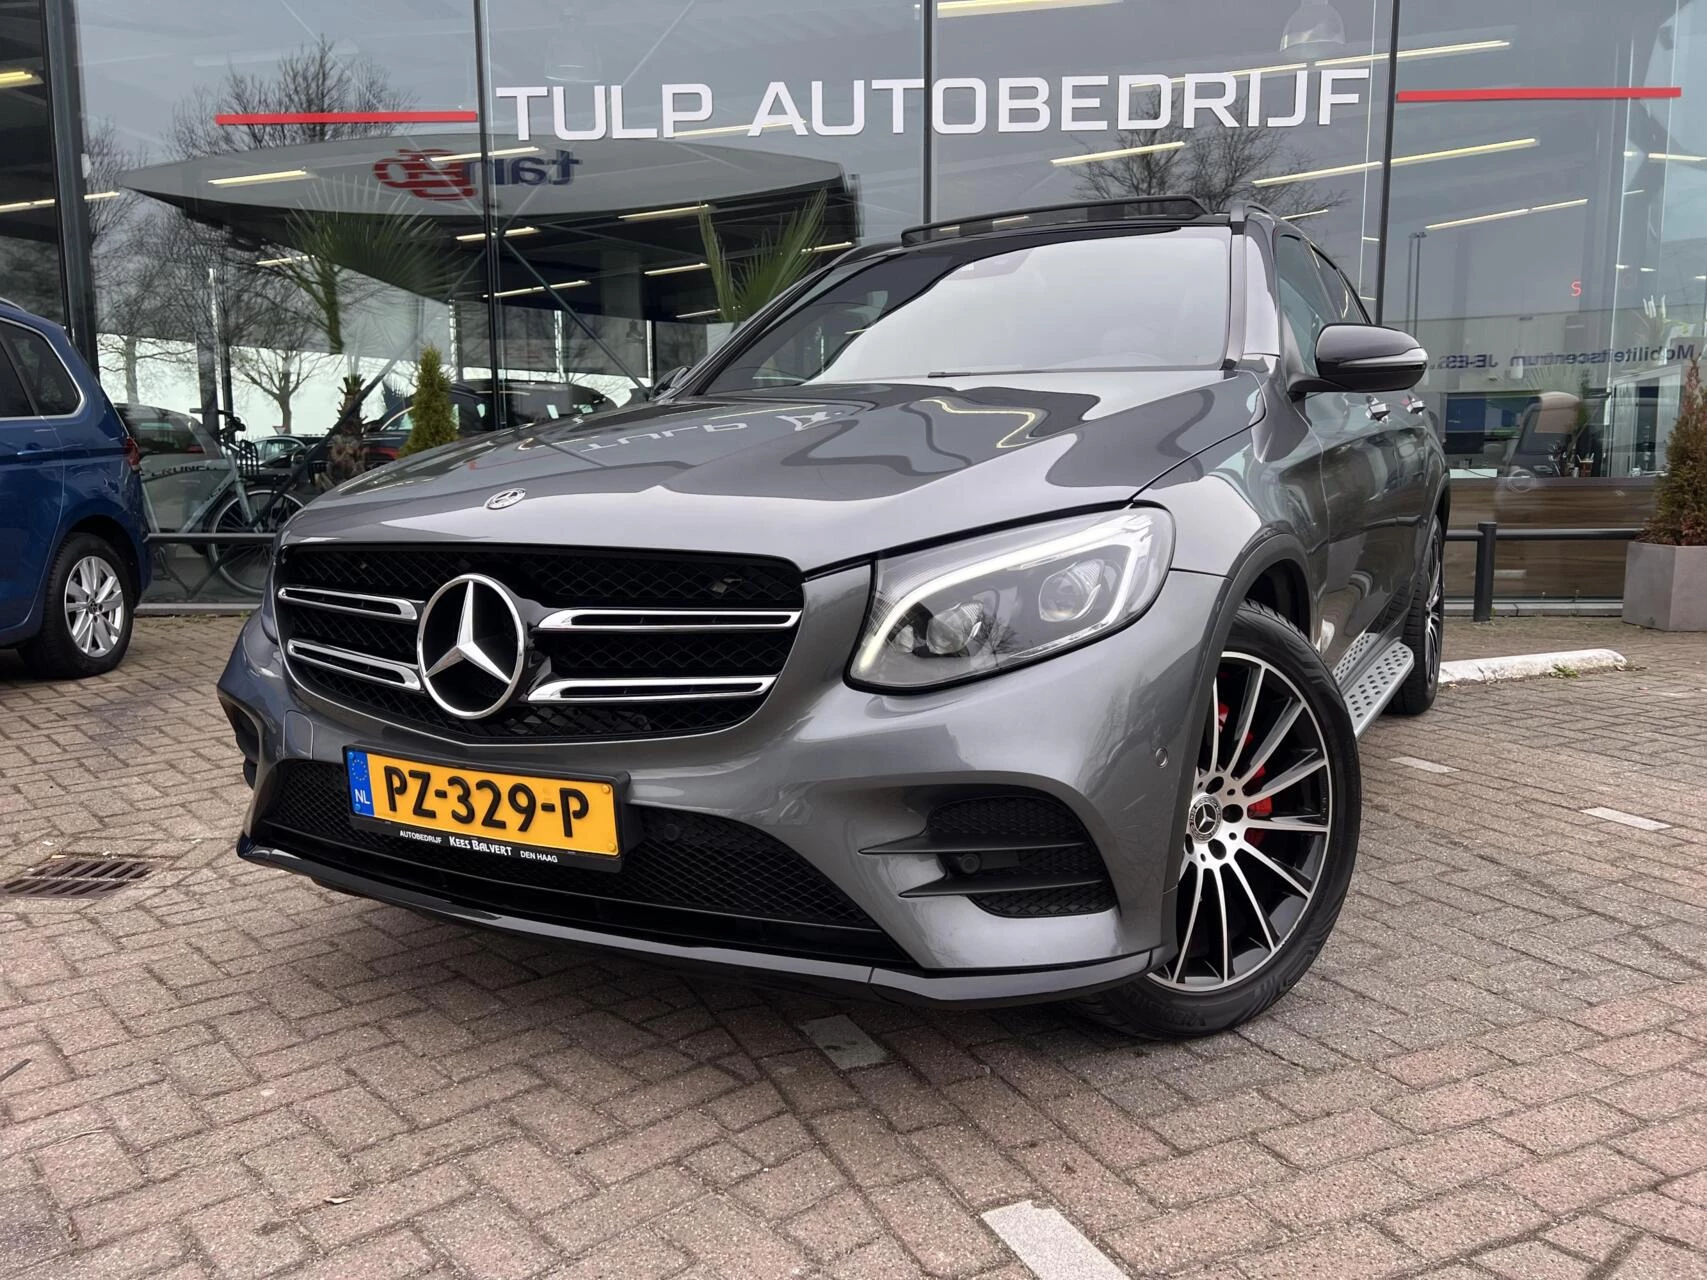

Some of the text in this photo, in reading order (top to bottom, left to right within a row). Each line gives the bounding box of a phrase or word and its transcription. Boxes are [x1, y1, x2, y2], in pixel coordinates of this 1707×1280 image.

[496, 69, 1369, 141] TULP AUTOBEDRIJF
[354, 788, 371, 805] NL
[383, 765, 590, 838] PZ-329-P
[400, 830, 443, 844] AUTOBEDRIJF
[472, 840, 512, 856] BALVERT
[520, 850, 536, 860] DEN
[537, 853, 558, 863] HAAG
